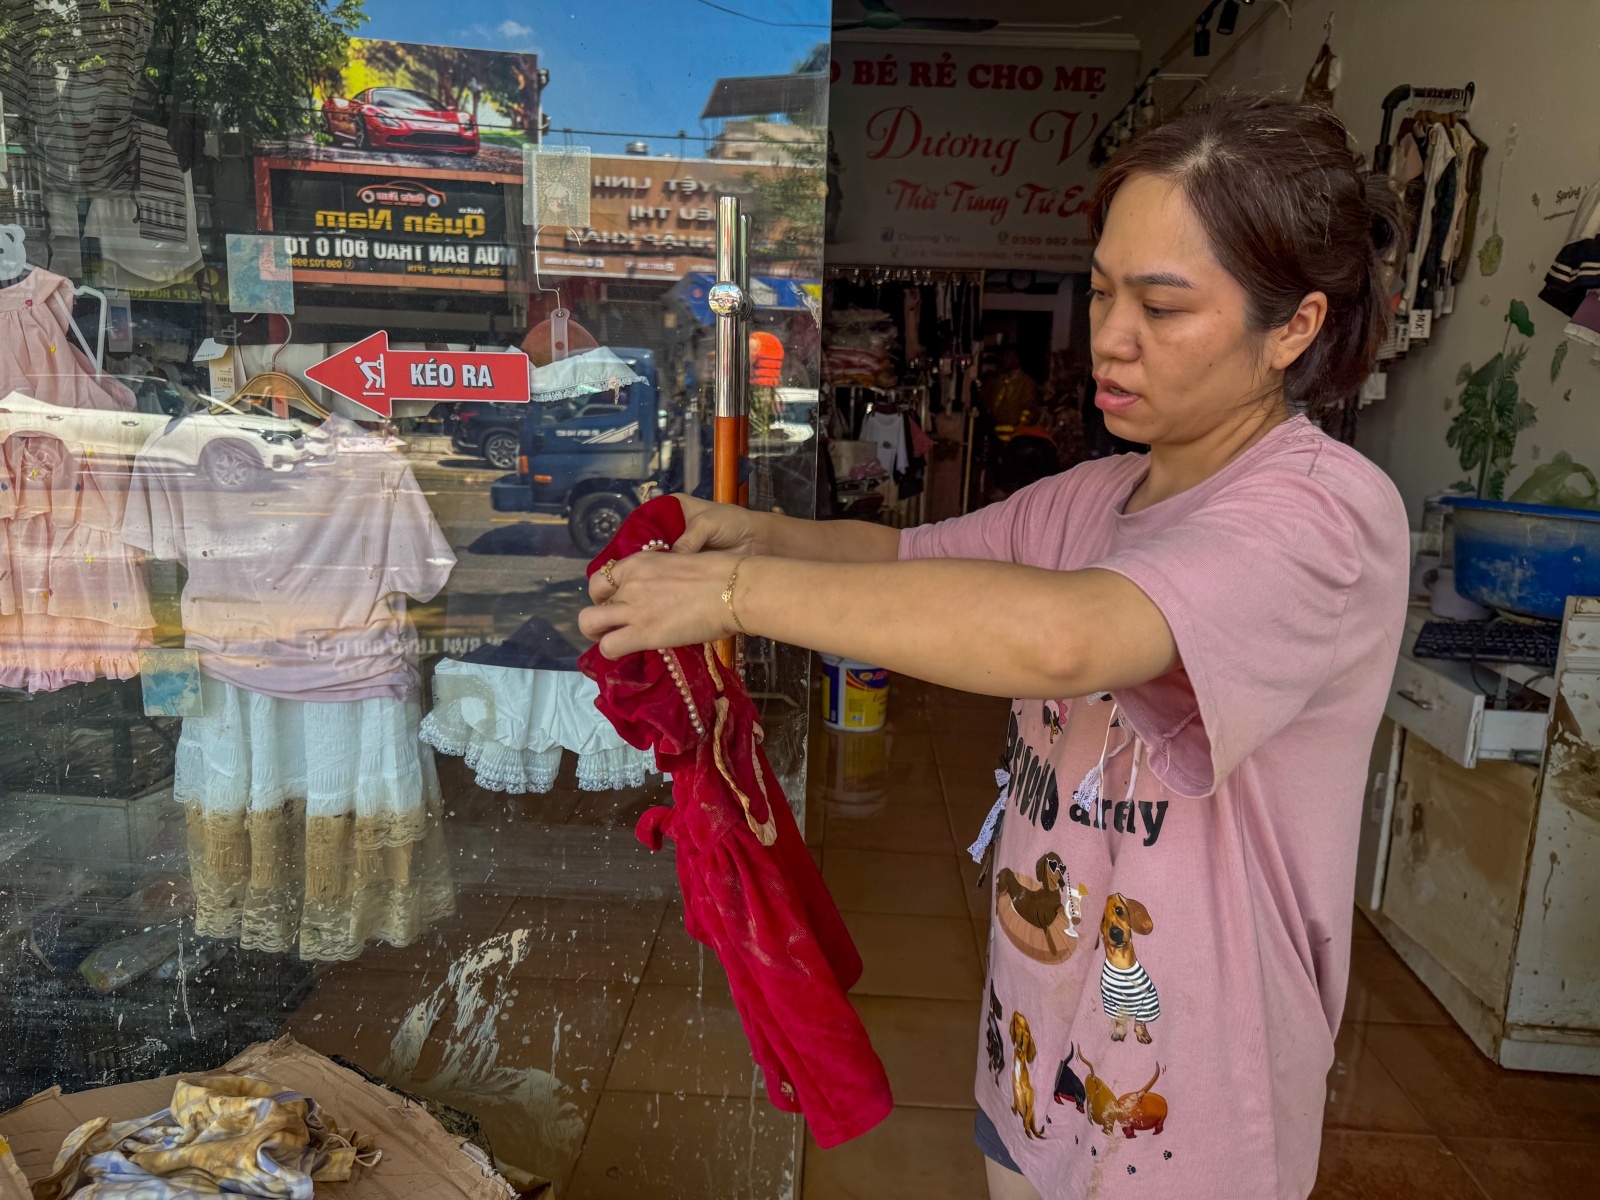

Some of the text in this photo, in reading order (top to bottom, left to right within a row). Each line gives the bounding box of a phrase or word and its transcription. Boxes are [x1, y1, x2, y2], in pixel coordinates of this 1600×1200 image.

[852, 54, 898, 86] BÉ
[908, 53, 957, 88] RẺ
[968, 63, 1044, 91] CHO
[1053, 66, 1107, 99] MẸ
[866, 105, 1098, 177] Dương V
[1556, 186, 1582, 205] Spring
[410, 358, 495, 388] KÉO RA
